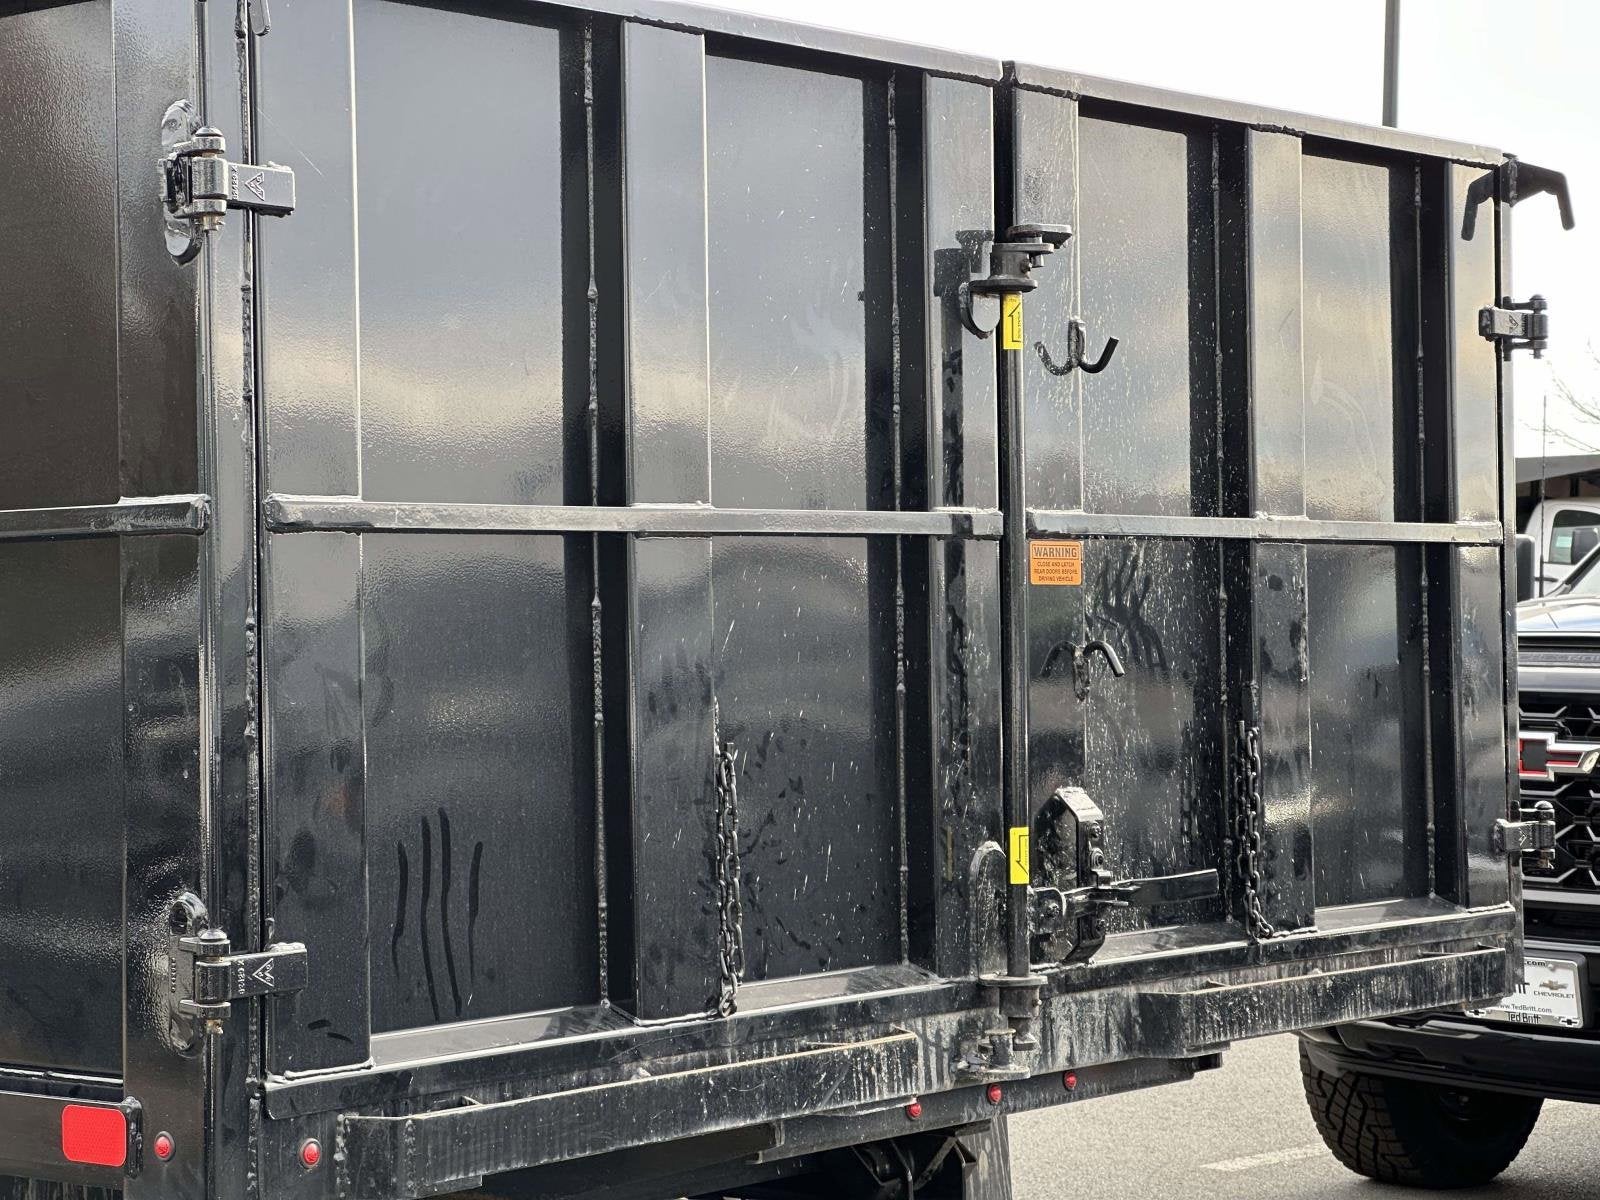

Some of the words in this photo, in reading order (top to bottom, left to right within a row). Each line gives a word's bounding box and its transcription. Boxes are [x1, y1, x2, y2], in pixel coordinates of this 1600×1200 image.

[1034, 547, 1077, 557] WARNING
[1533, 990, 1575, 999] CHEVROLET
[1508, 1011, 1520, 1022] Ted
[1522, 1012, 1541, 1024] Britt
